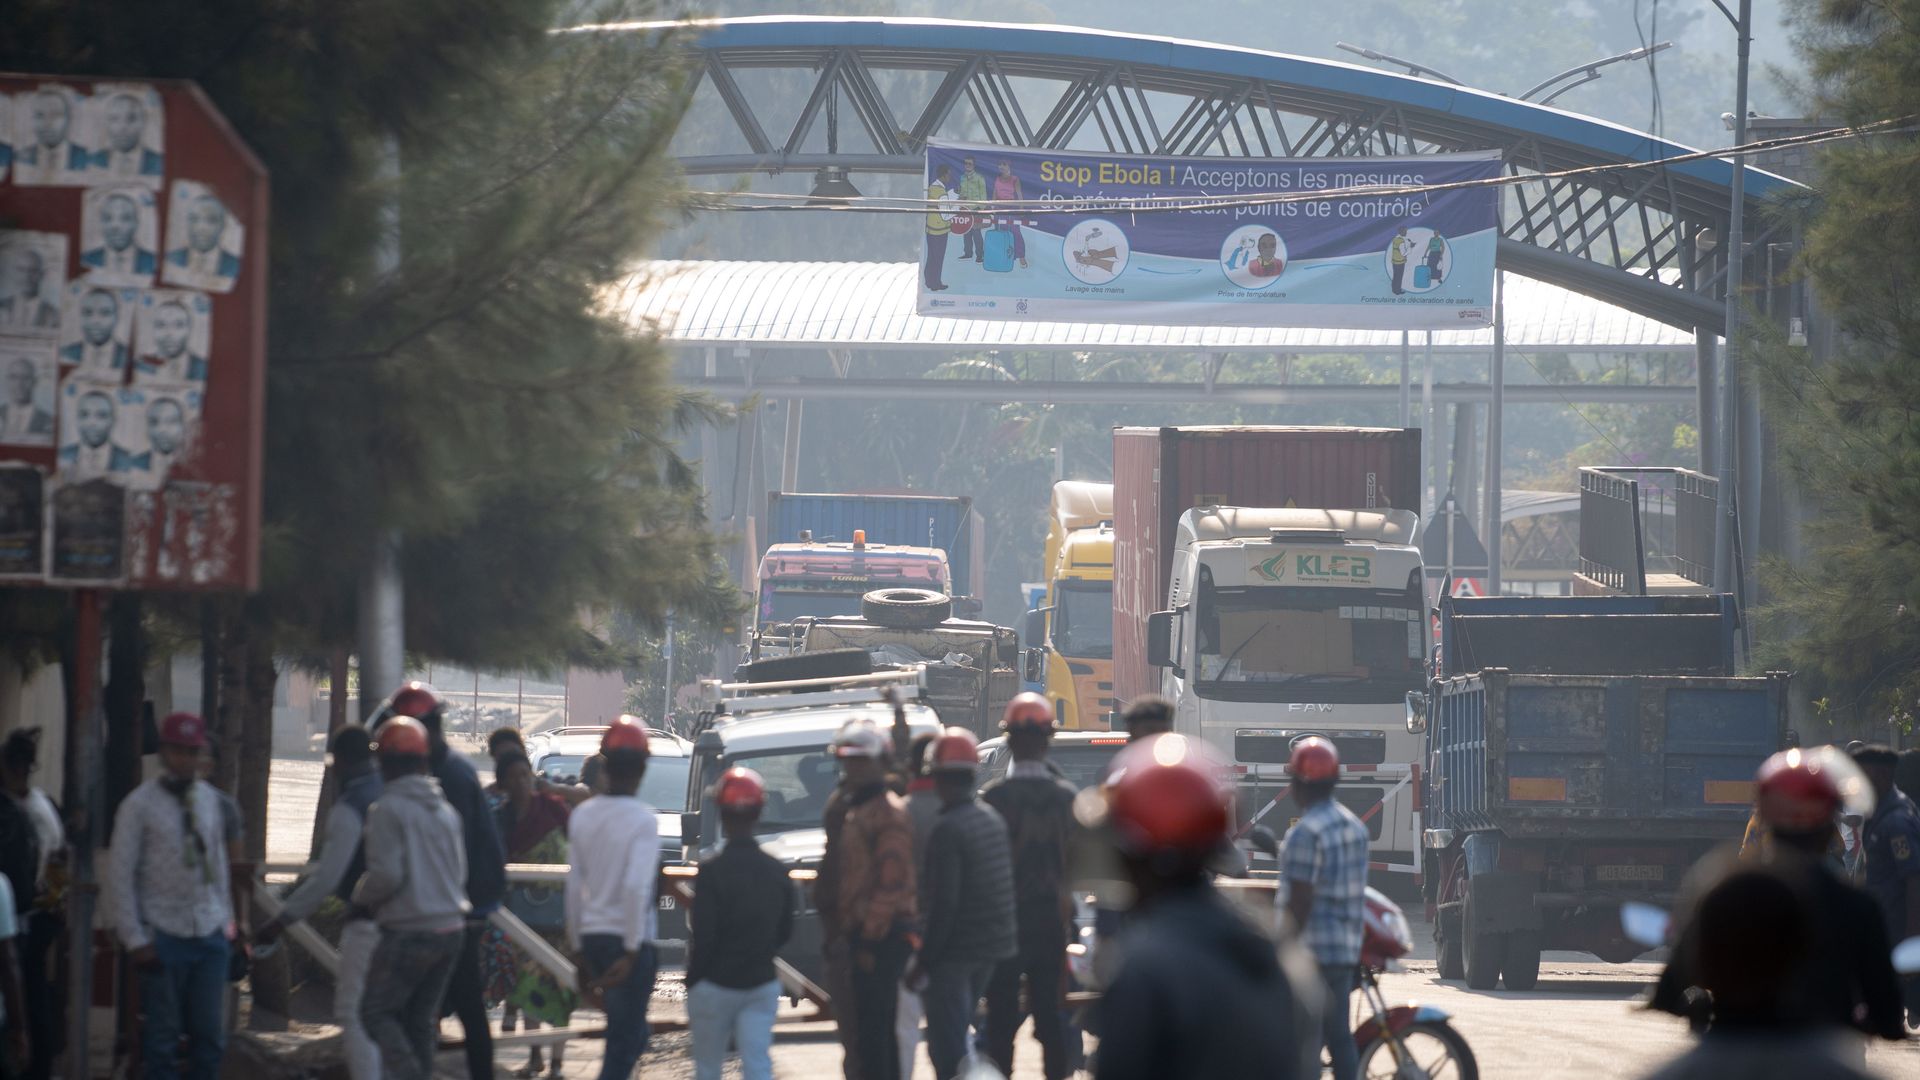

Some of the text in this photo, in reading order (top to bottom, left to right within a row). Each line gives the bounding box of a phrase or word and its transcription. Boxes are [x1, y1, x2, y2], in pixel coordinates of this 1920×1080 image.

[1039, 161, 1424, 192] Stop Ebola ! Acceptons les mesures
[1039, 188, 1065, 209] de
[1235, 198, 1297, 220] points
[1305, 198, 1331, 217] de
[1338, 197, 1422, 218] contrôle
[951, 216, 970, 225] TOP
[1065, 285, 1090, 294] Lavage
[1246, 290, 1287, 298] température
[1360, 296, 1396, 304] Formulaire
[1398, 296, 1406, 304] de
[1408, 296, 1445, 304] déclaration
[1455, 297, 1474, 305] santé
[1288, 703, 1334, 713] FAW
